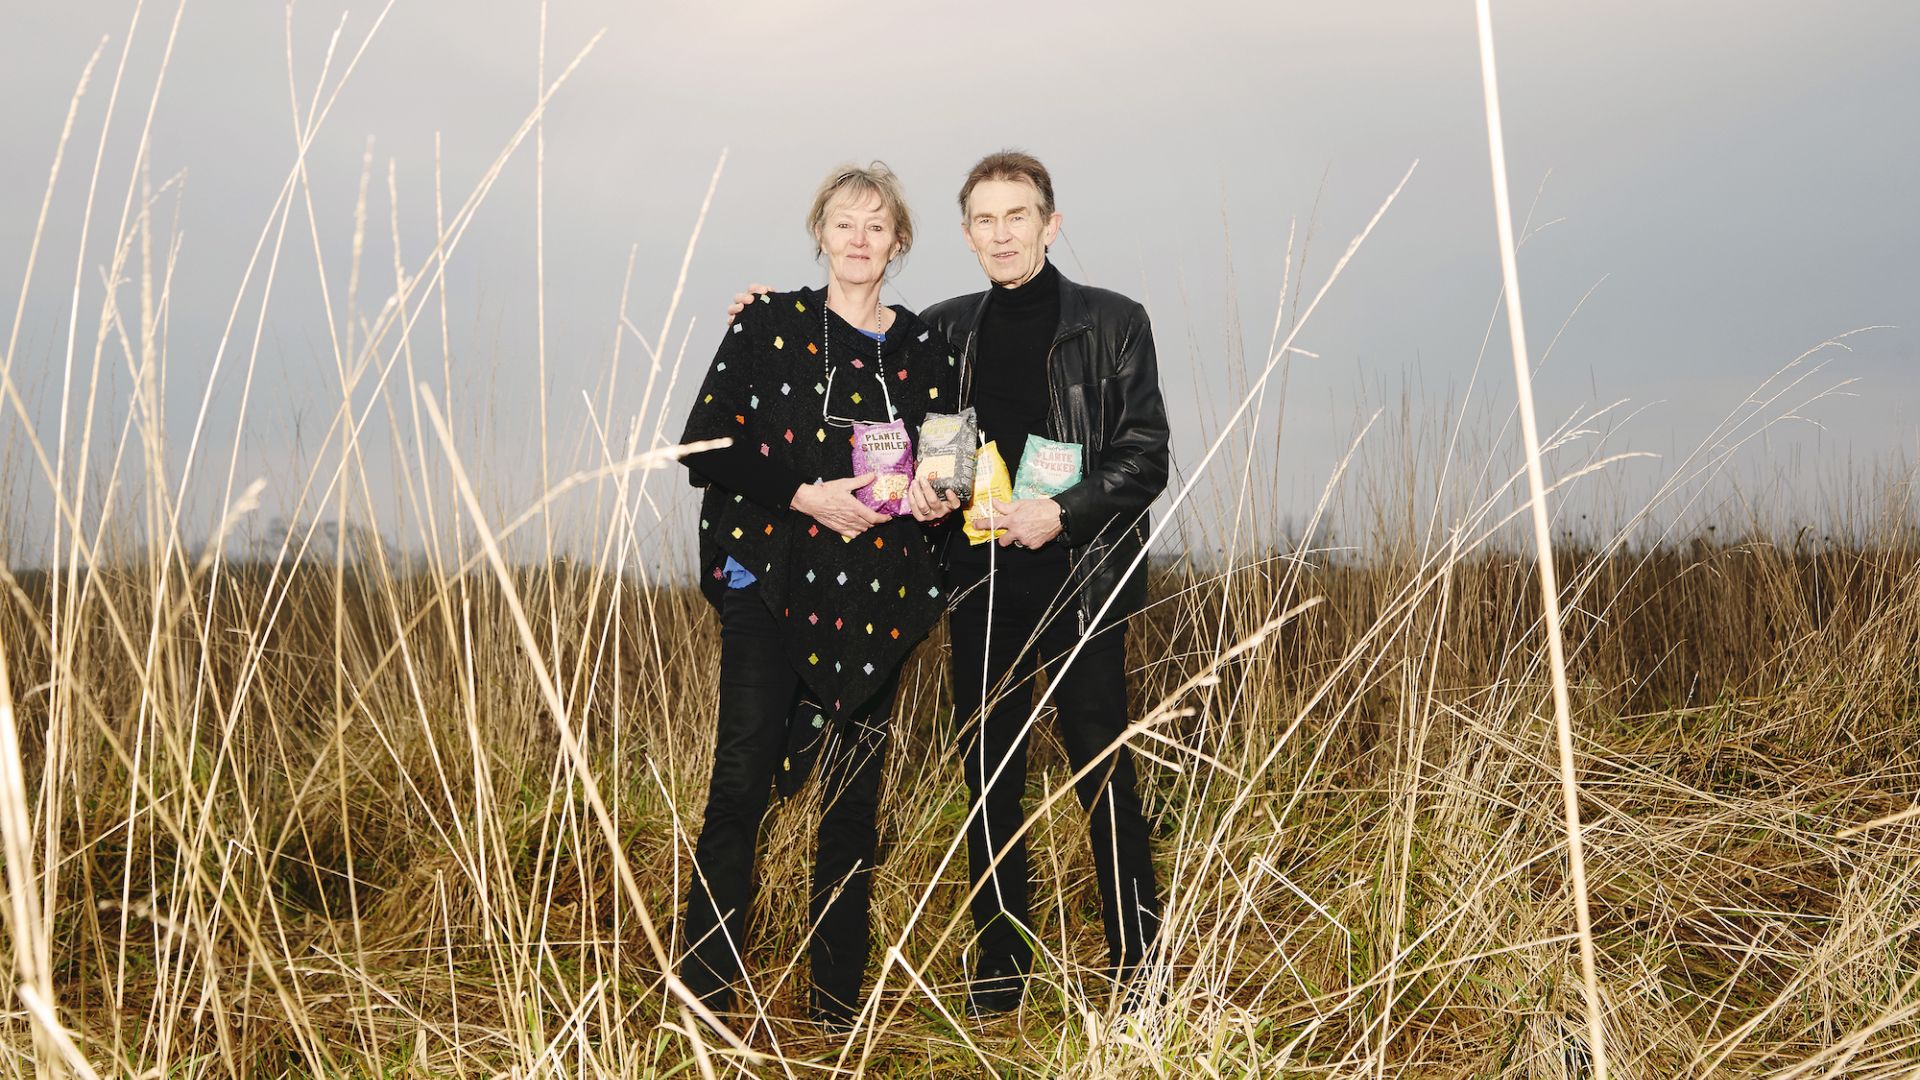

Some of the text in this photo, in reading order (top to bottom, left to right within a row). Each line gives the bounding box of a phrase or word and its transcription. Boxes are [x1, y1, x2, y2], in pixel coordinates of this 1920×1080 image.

[865, 432, 902, 441] PLANTE
[861, 441, 908, 452] STRIMLER
[1036, 451, 1073, 463] PLANTE
[1032, 459, 1076, 473] STYKKER
